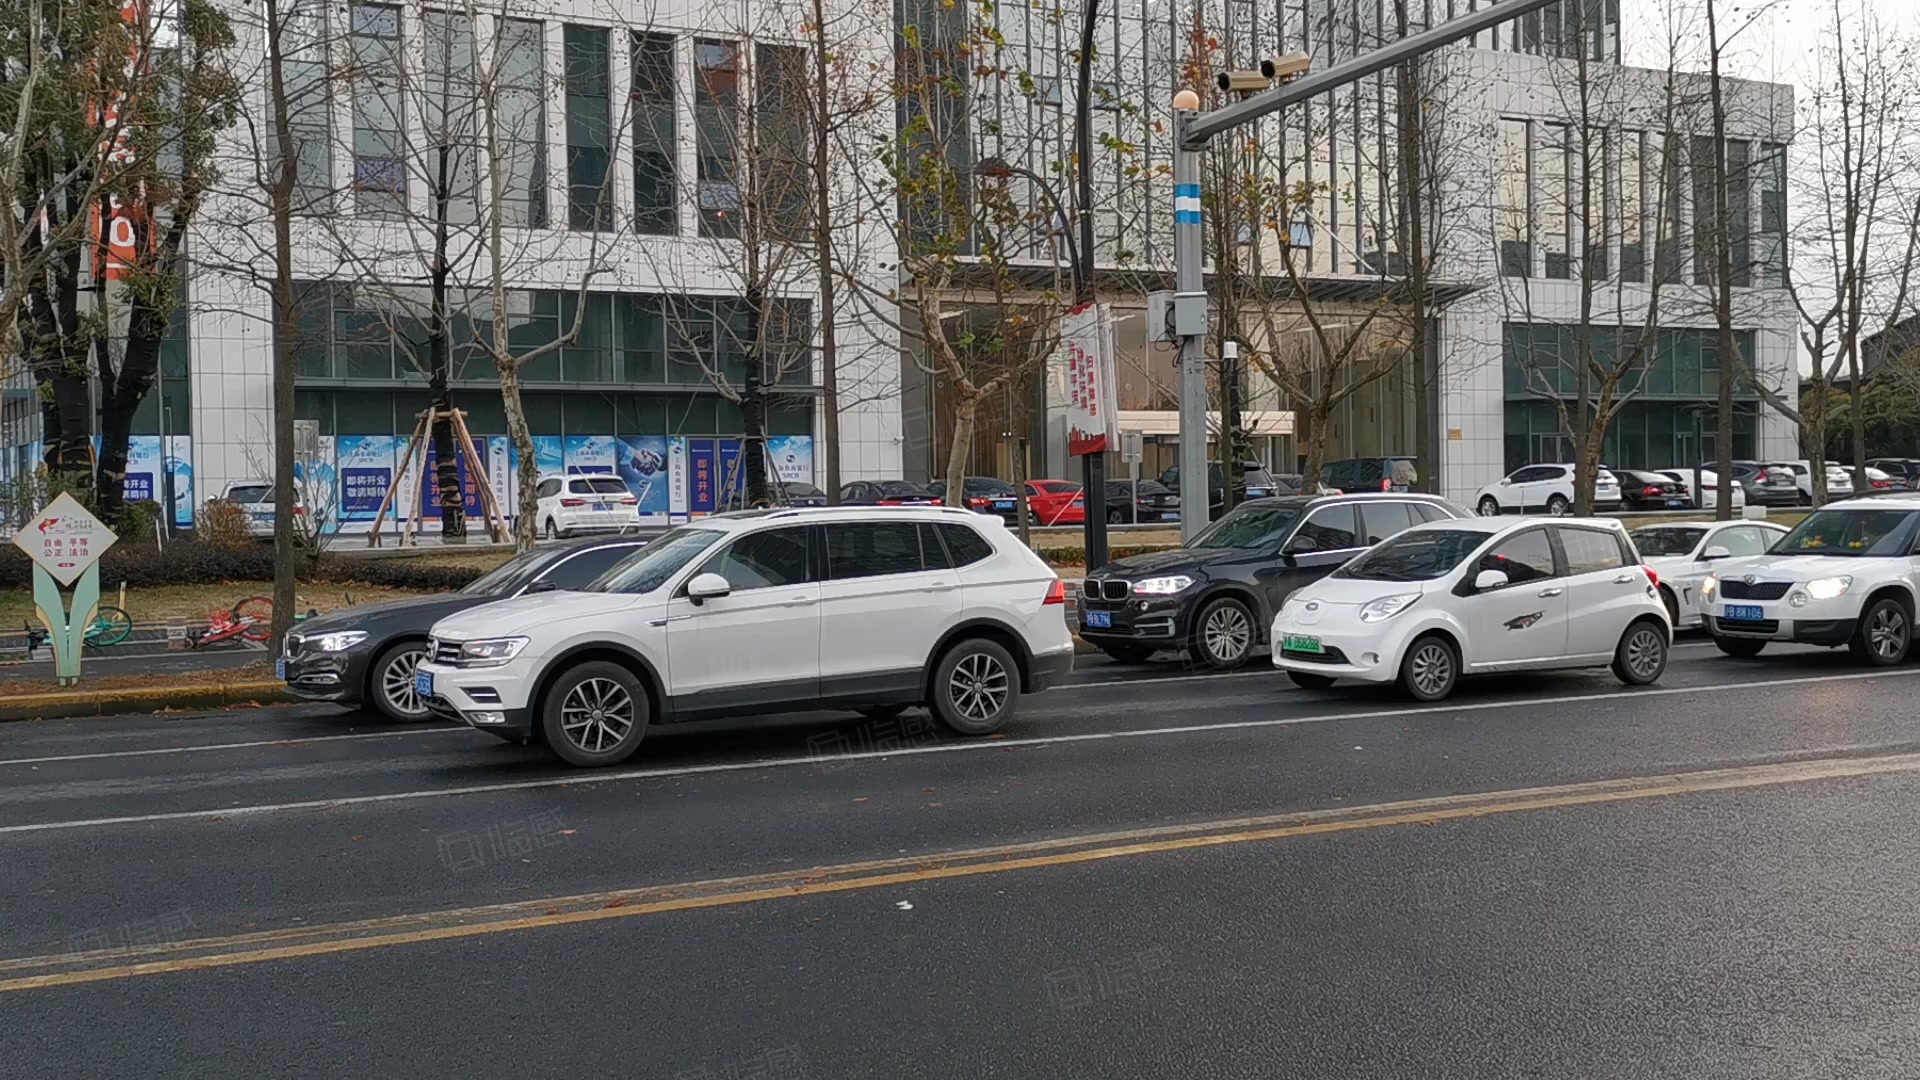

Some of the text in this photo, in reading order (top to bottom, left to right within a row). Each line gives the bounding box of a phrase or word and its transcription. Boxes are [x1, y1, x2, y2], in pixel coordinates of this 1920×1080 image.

[346, 475, 386, 486] 即将开业
[697, 459, 708, 502] 即将开业
[43, 537, 89, 548] 自由 平等
[43, 548, 89, 557] 公正 法治
